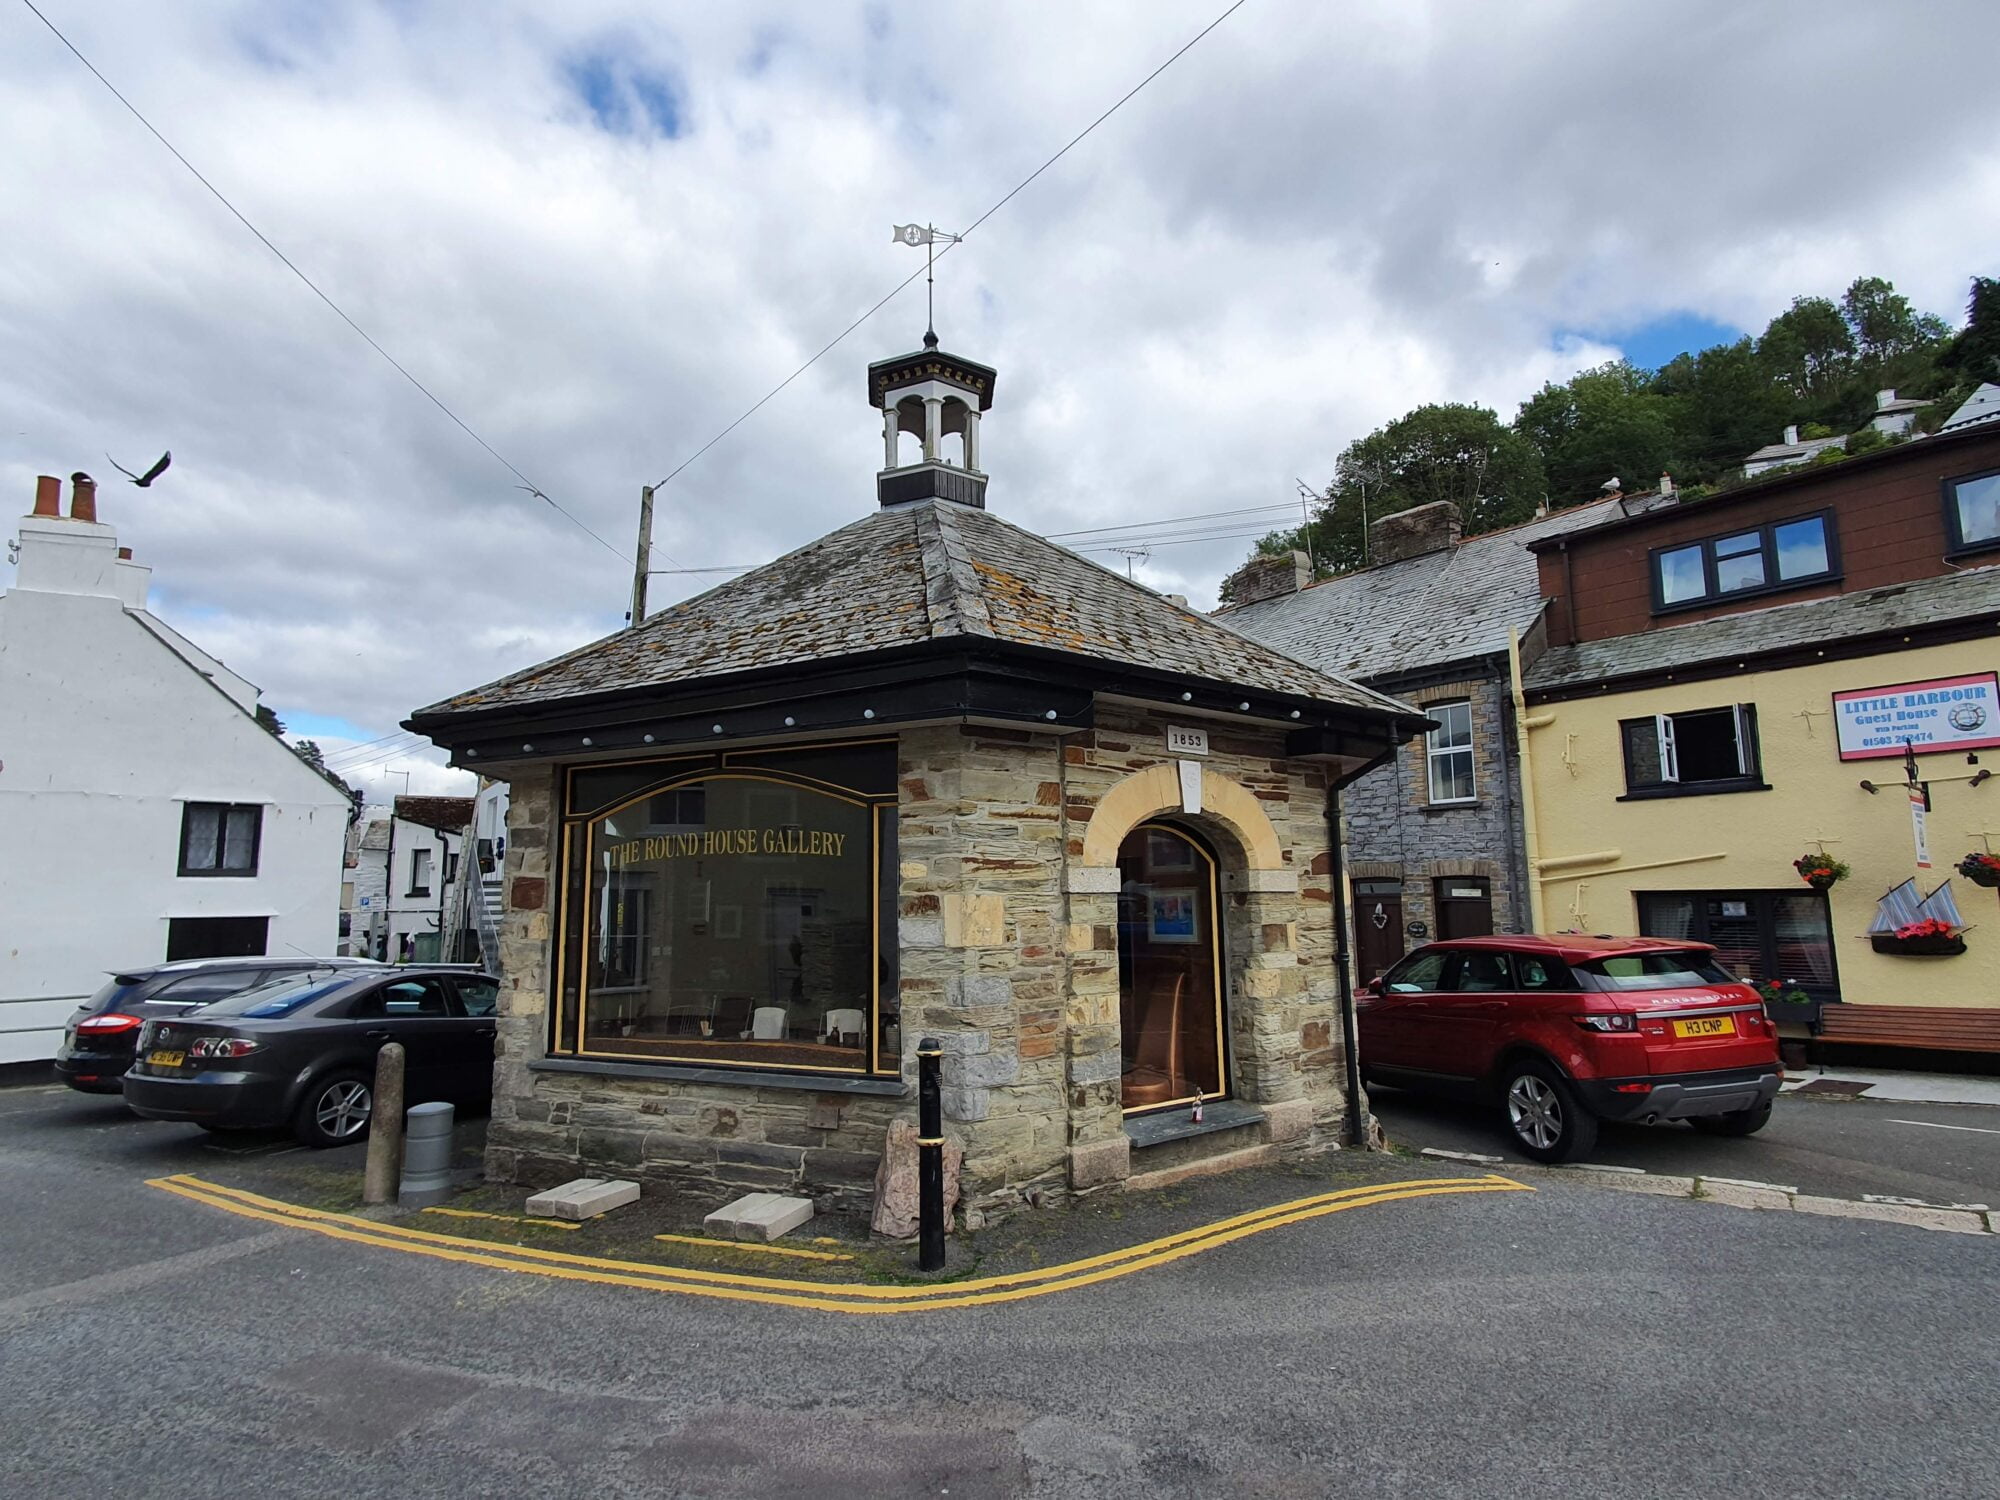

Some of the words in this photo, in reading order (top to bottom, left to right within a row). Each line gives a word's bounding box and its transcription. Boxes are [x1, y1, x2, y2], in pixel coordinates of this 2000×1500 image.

[1845, 697, 1898, 714] LITTLE
[1904, 687, 1986, 707] HARBOUR
[1855, 713, 1892, 725] Guest
[1896, 708, 1938, 721] House
[1173, 733, 1201, 746] 1853
[1862, 736, 1893, 747] 01503
[609, 839, 640, 867] THE
[644, 832, 699, 860] ROUND
[703, 830, 758, 856] HOUSE
[763, 828, 846, 857] GALLERY
[1651, 996, 1698, 1005] RANGE
[1704, 993, 1743, 1002] ROVER
[1685, 1021, 1701, 1034] H3
[1704, 1020, 1722, 1033] CNP
